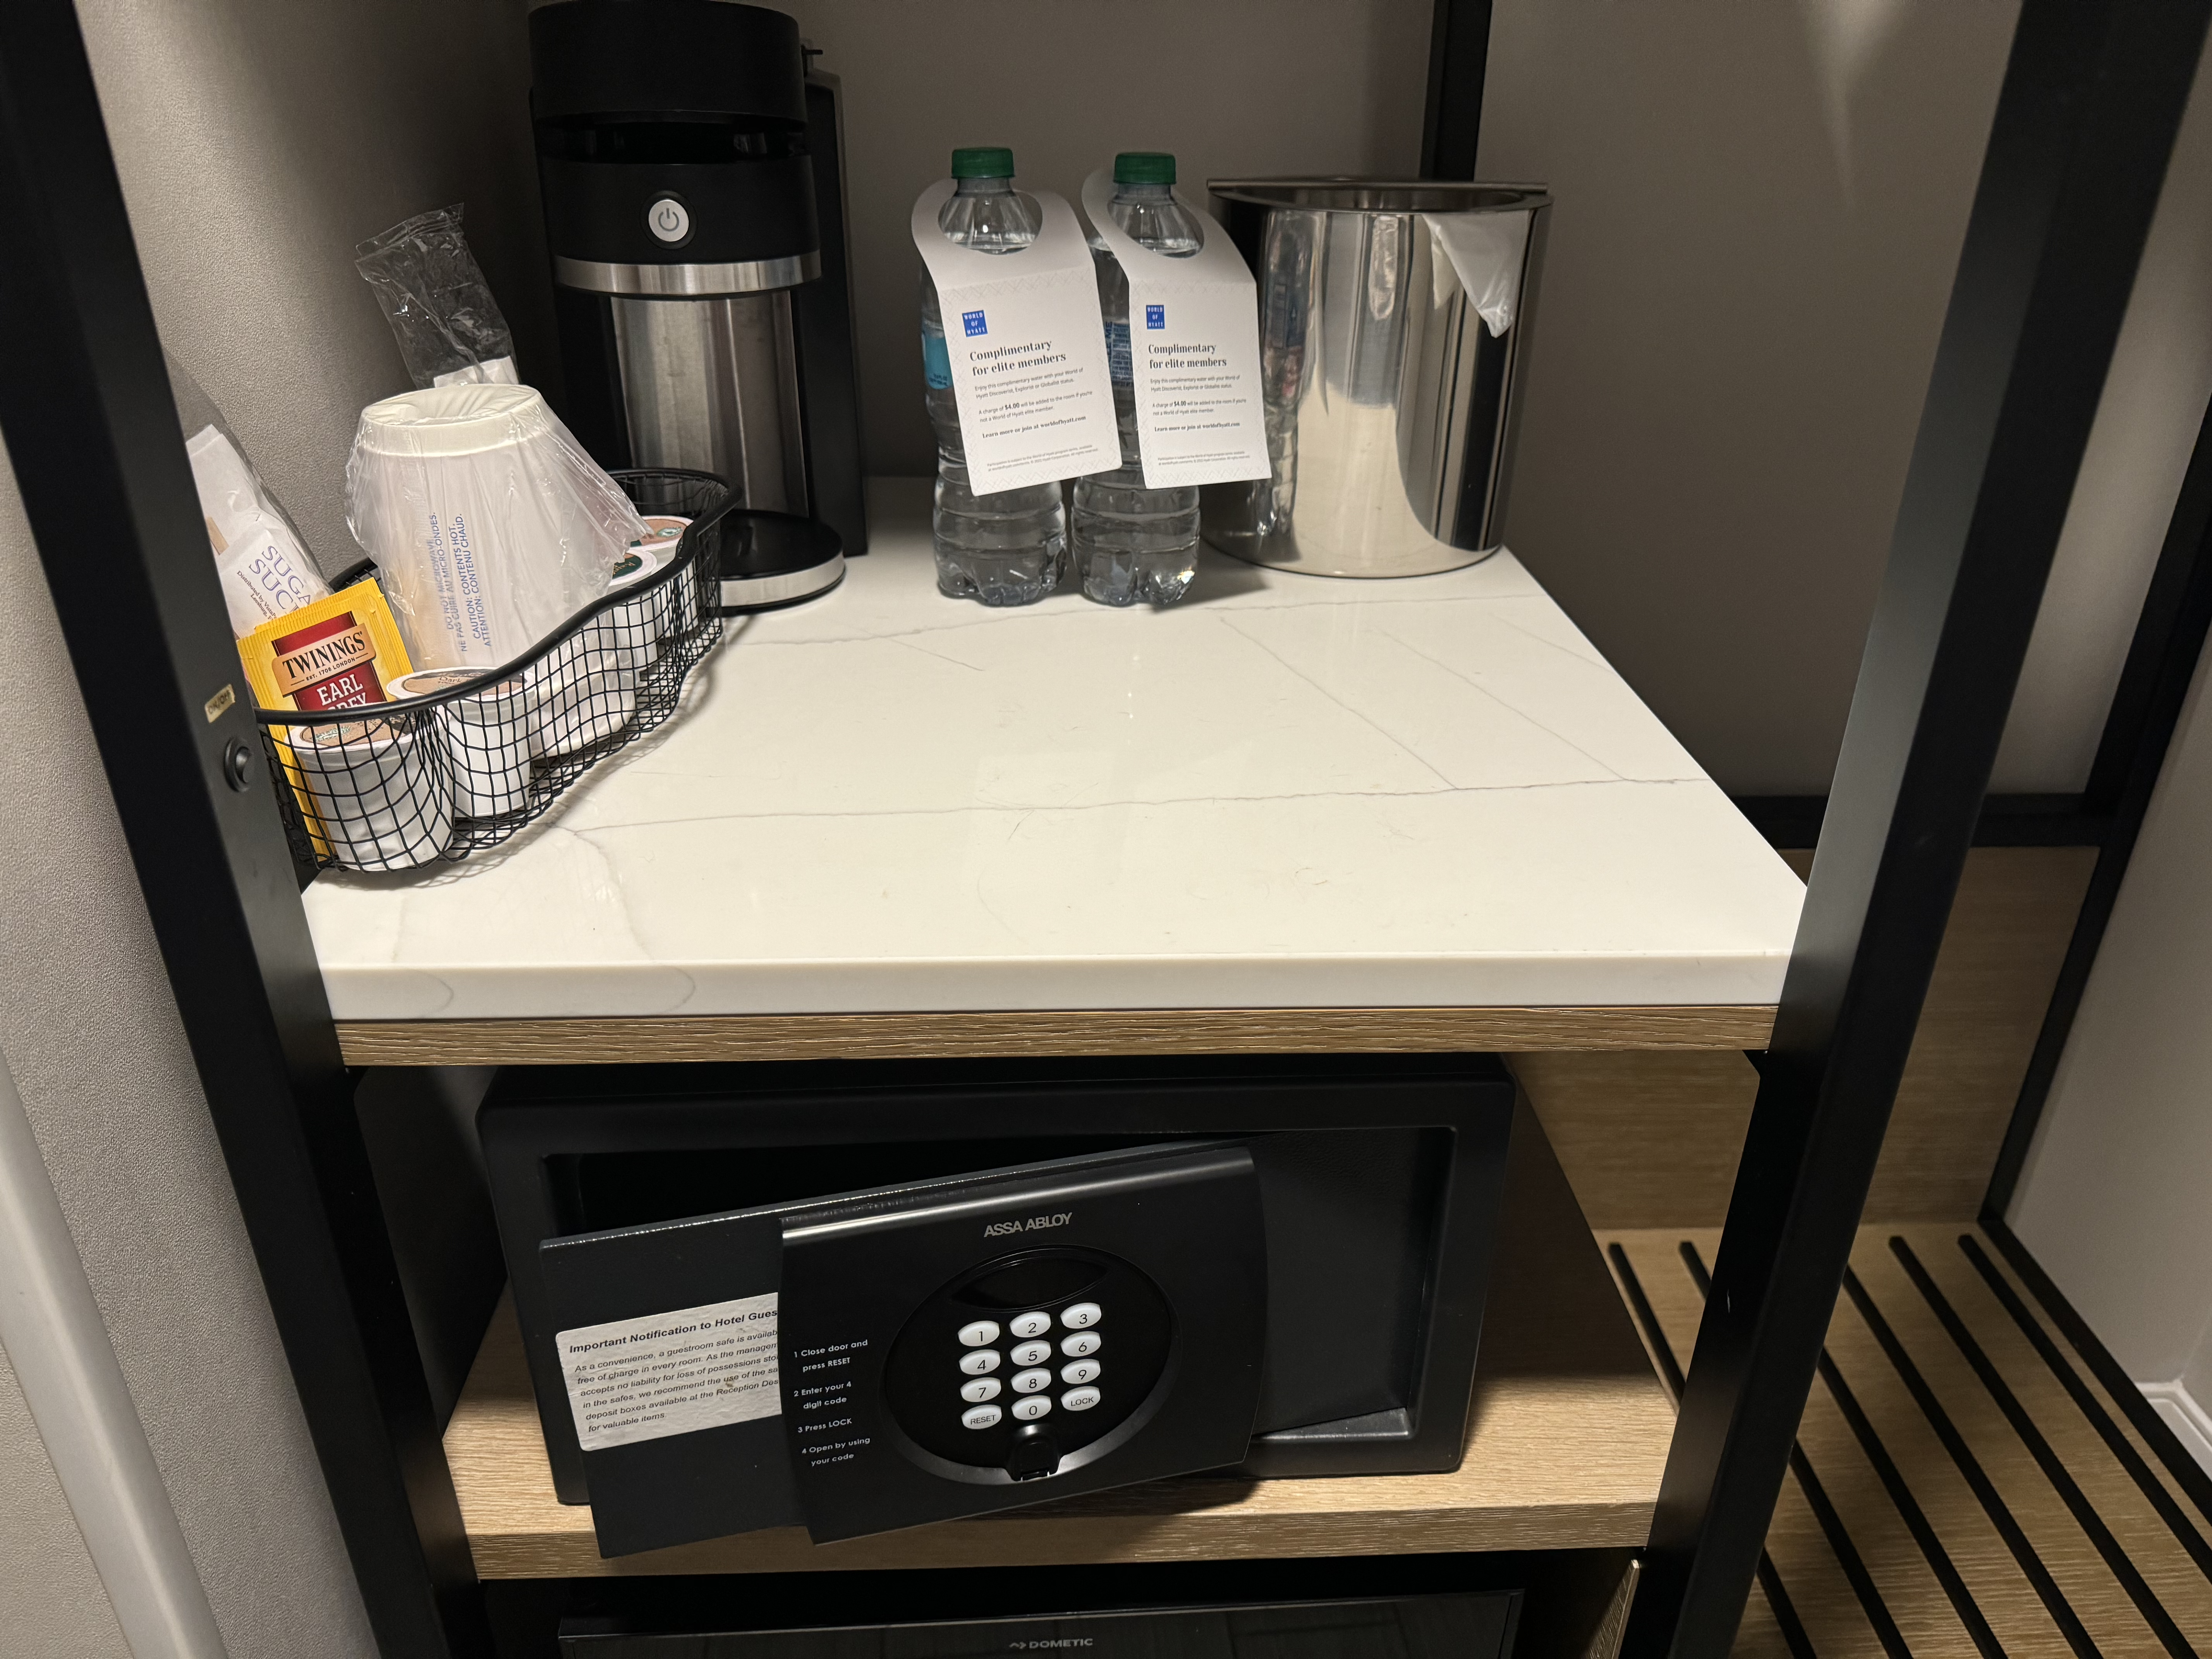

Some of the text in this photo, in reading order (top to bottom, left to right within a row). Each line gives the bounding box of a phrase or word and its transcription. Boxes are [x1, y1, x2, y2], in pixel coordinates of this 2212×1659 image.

[970, 341, 1052, 361] Complimentary
[1148, 344, 1216, 356] Complimentary
[972, 354, 1066, 376] for elite members
[1150, 357, 1227, 369] for elite members
[1040, 416, 1086, 428] worldofhyatt.com
[237, 570, 260, 596] Distributed
[449, 524, 481, 639] CAUTION: CONTENTS HOT.
[455, 514, 491, 646] ATTENTION: CONTENU CHAUD.
[319, 667, 332, 676] 1706
[333, 657, 356, 670] LONDON
[316, 674, 363, 706] EARL
[984, 1212, 1072, 1238] ASSA ABLOY
[1079, 1314, 1088, 1324] 3
[570, 1336, 627, 1353] Important
[630, 1325, 696, 1343] Notification
[715, 1314, 745, 1327] Hotel
[1028, 1322, 1037, 1333] 2
[978, 1331, 984, 1341] 1
[598, 1353, 656, 1368] convenience,
[667, 1343, 714, 1357] guestroom
[716, 1338, 735, 1346] safe
[801, 1348, 826, 1357] Close
[828, 1344, 848, 1352] door
[851, 1339, 868, 1348] and
[1079, 1341, 1087, 1352] 6
[1028, 1350, 1037, 1361] 5
[608, 1369, 639, 1381] charge
[652, 1362, 677, 1371] every
[678, 1357, 703, 1366] room.
[803, 1357, 850, 1373] press RESET
[977, 1359, 986, 1370] 4
[580, 1386, 615, 1396] accepts
[631, 1377, 661, 1387] liability
[708, 1358, 761, 1374] possessions
[1078, 1369, 1087, 1379] 9
[610, 1395, 635, 1403] safes,
[654, 1380, 705, 1395] recommend
[723, 1375, 739, 1384] use
[801, 1388, 823, 1396] Enter
[825, 1383, 844, 1393] your
[1029, 1378, 1037, 1389] 8
[978, 1388, 986, 1398] 7
[586, 1409, 617, 1420] deposit
[620, 1405, 646, 1414] boxes
[649, 1396, 687, 1408] available
[716, 1383, 759, 1396] Reception
[803, 1396, 847, 1409] digit code
[1070, 1396, 1094, 1406] LOCK
[1029, 1406, 1037, 1416] 0
[602, 1417, 639, 1429] valuable
[805, 1424, 826, 1432] Press
[829, 1418, 852, 1428] LOCK
[970, 1414, 996, 1424] RESET
[809, 1445, 833, 1453] Open
[848, 1438, 870, 1446] using
[811, 1453, 854, 1467] your code
[1029, 1638, 1093, 1649] DOMETIC
